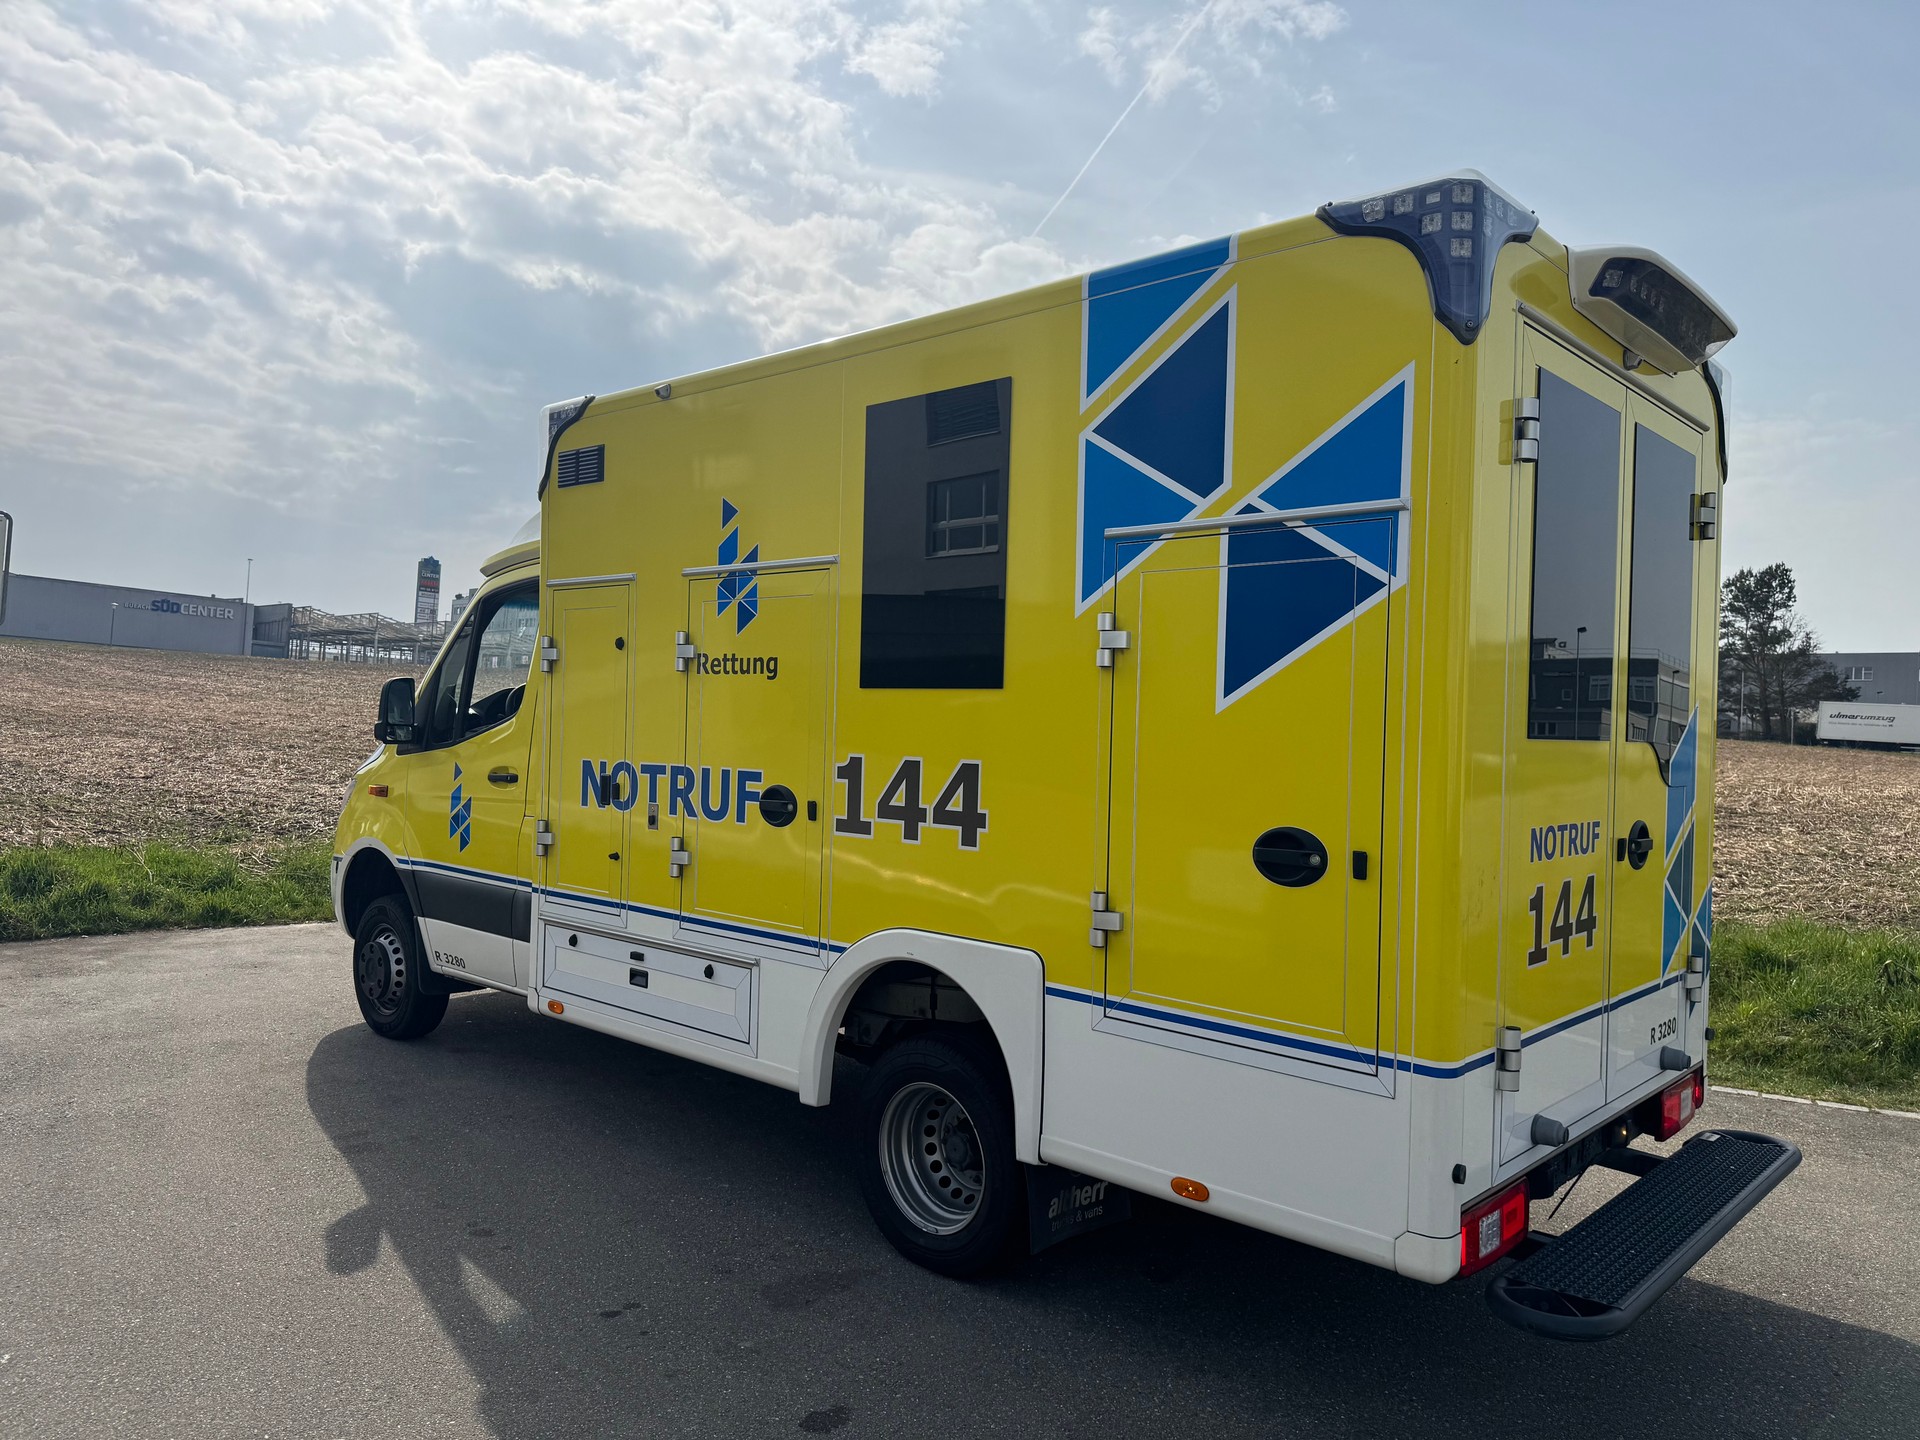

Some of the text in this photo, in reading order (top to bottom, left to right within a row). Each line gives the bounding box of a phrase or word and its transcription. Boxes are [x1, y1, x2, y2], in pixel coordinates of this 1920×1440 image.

[695, 653, 779, 680] Rettung
[1829, 712, 1896, 723] ulmerumzug
[580, 753, 988, 851] NOTRUF 144
[1530, 820, 1600, 863] NOTRUF
[1527, 873, 1597, 969] 144
[434, 950, 466, 969] R 3280
[1650, 1016, 1677, 1045] R 3280
[1084, 1205, 1103, 1219] vans
